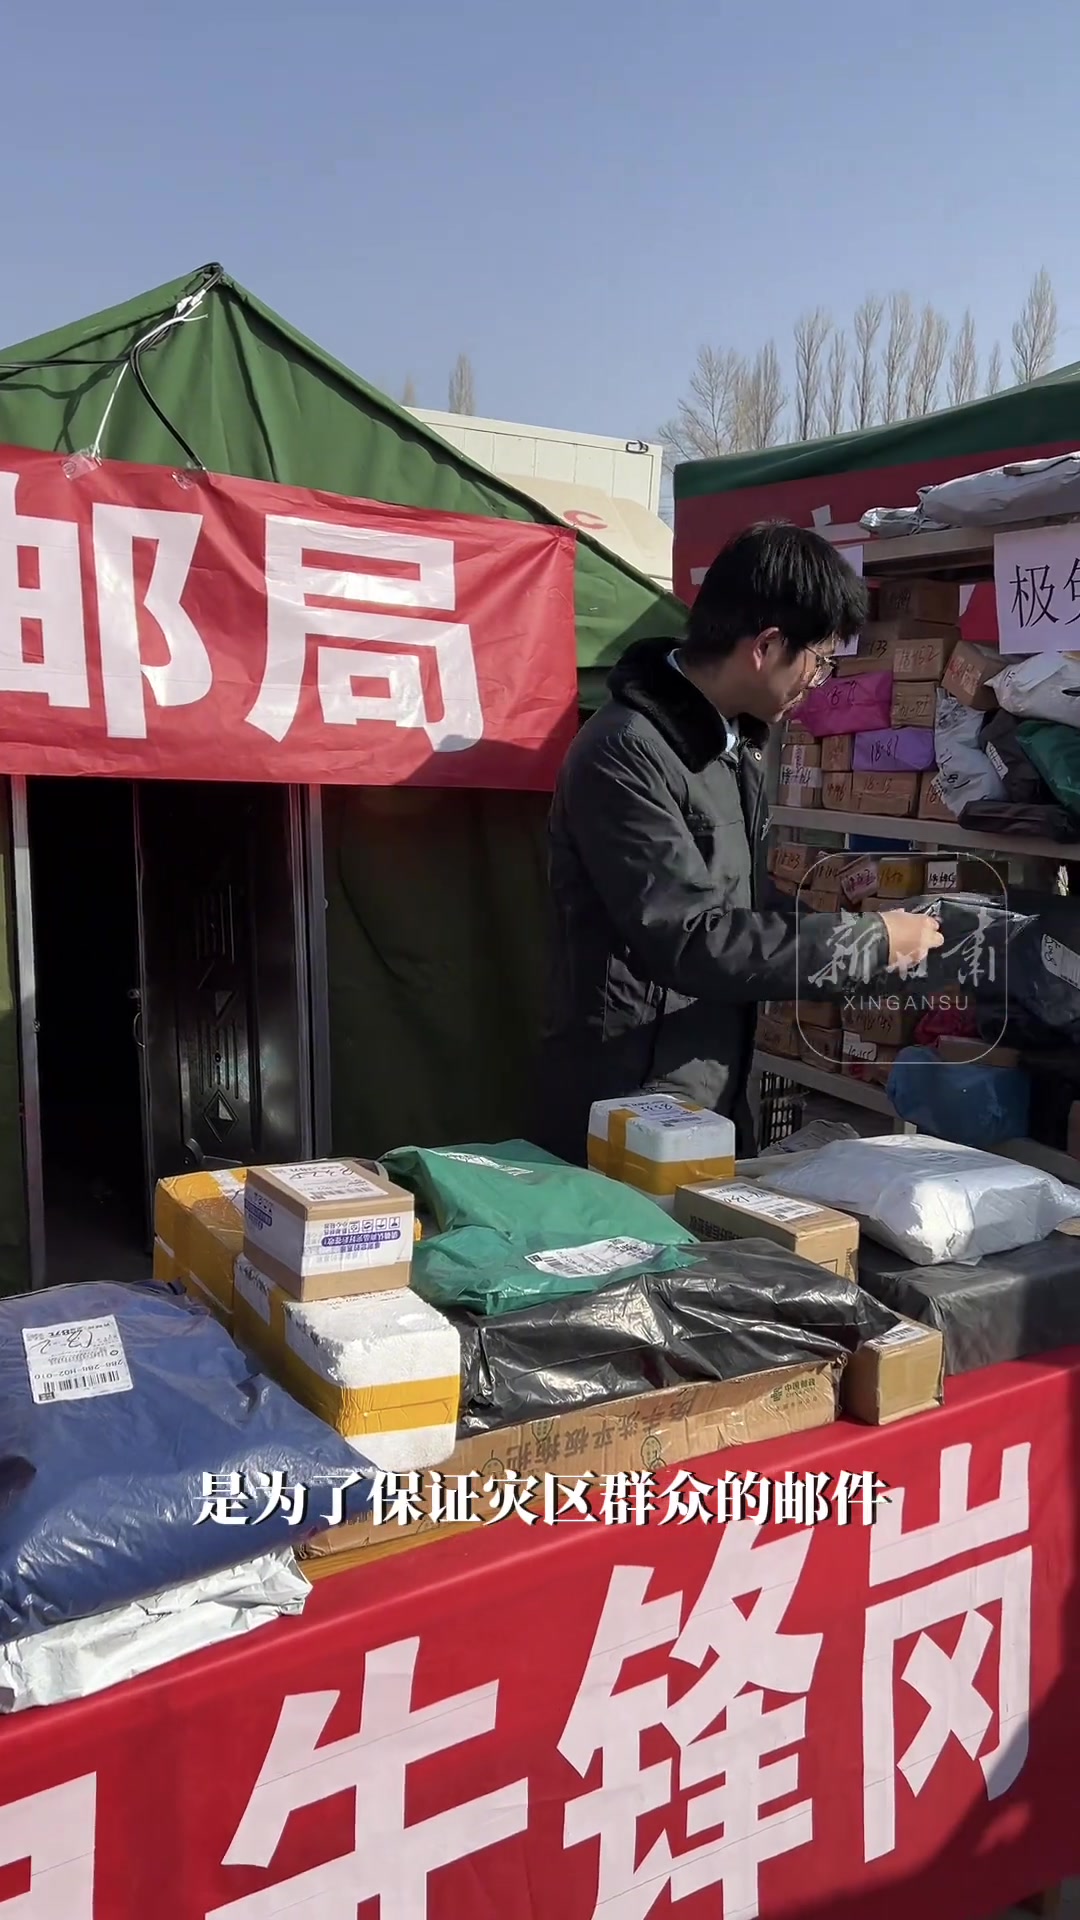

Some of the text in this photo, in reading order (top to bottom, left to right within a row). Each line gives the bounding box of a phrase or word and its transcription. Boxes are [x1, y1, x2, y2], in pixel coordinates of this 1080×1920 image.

[0, 471, 485, 753] 邮局
[0, 1443, 1032, 1920] 先锋岗
